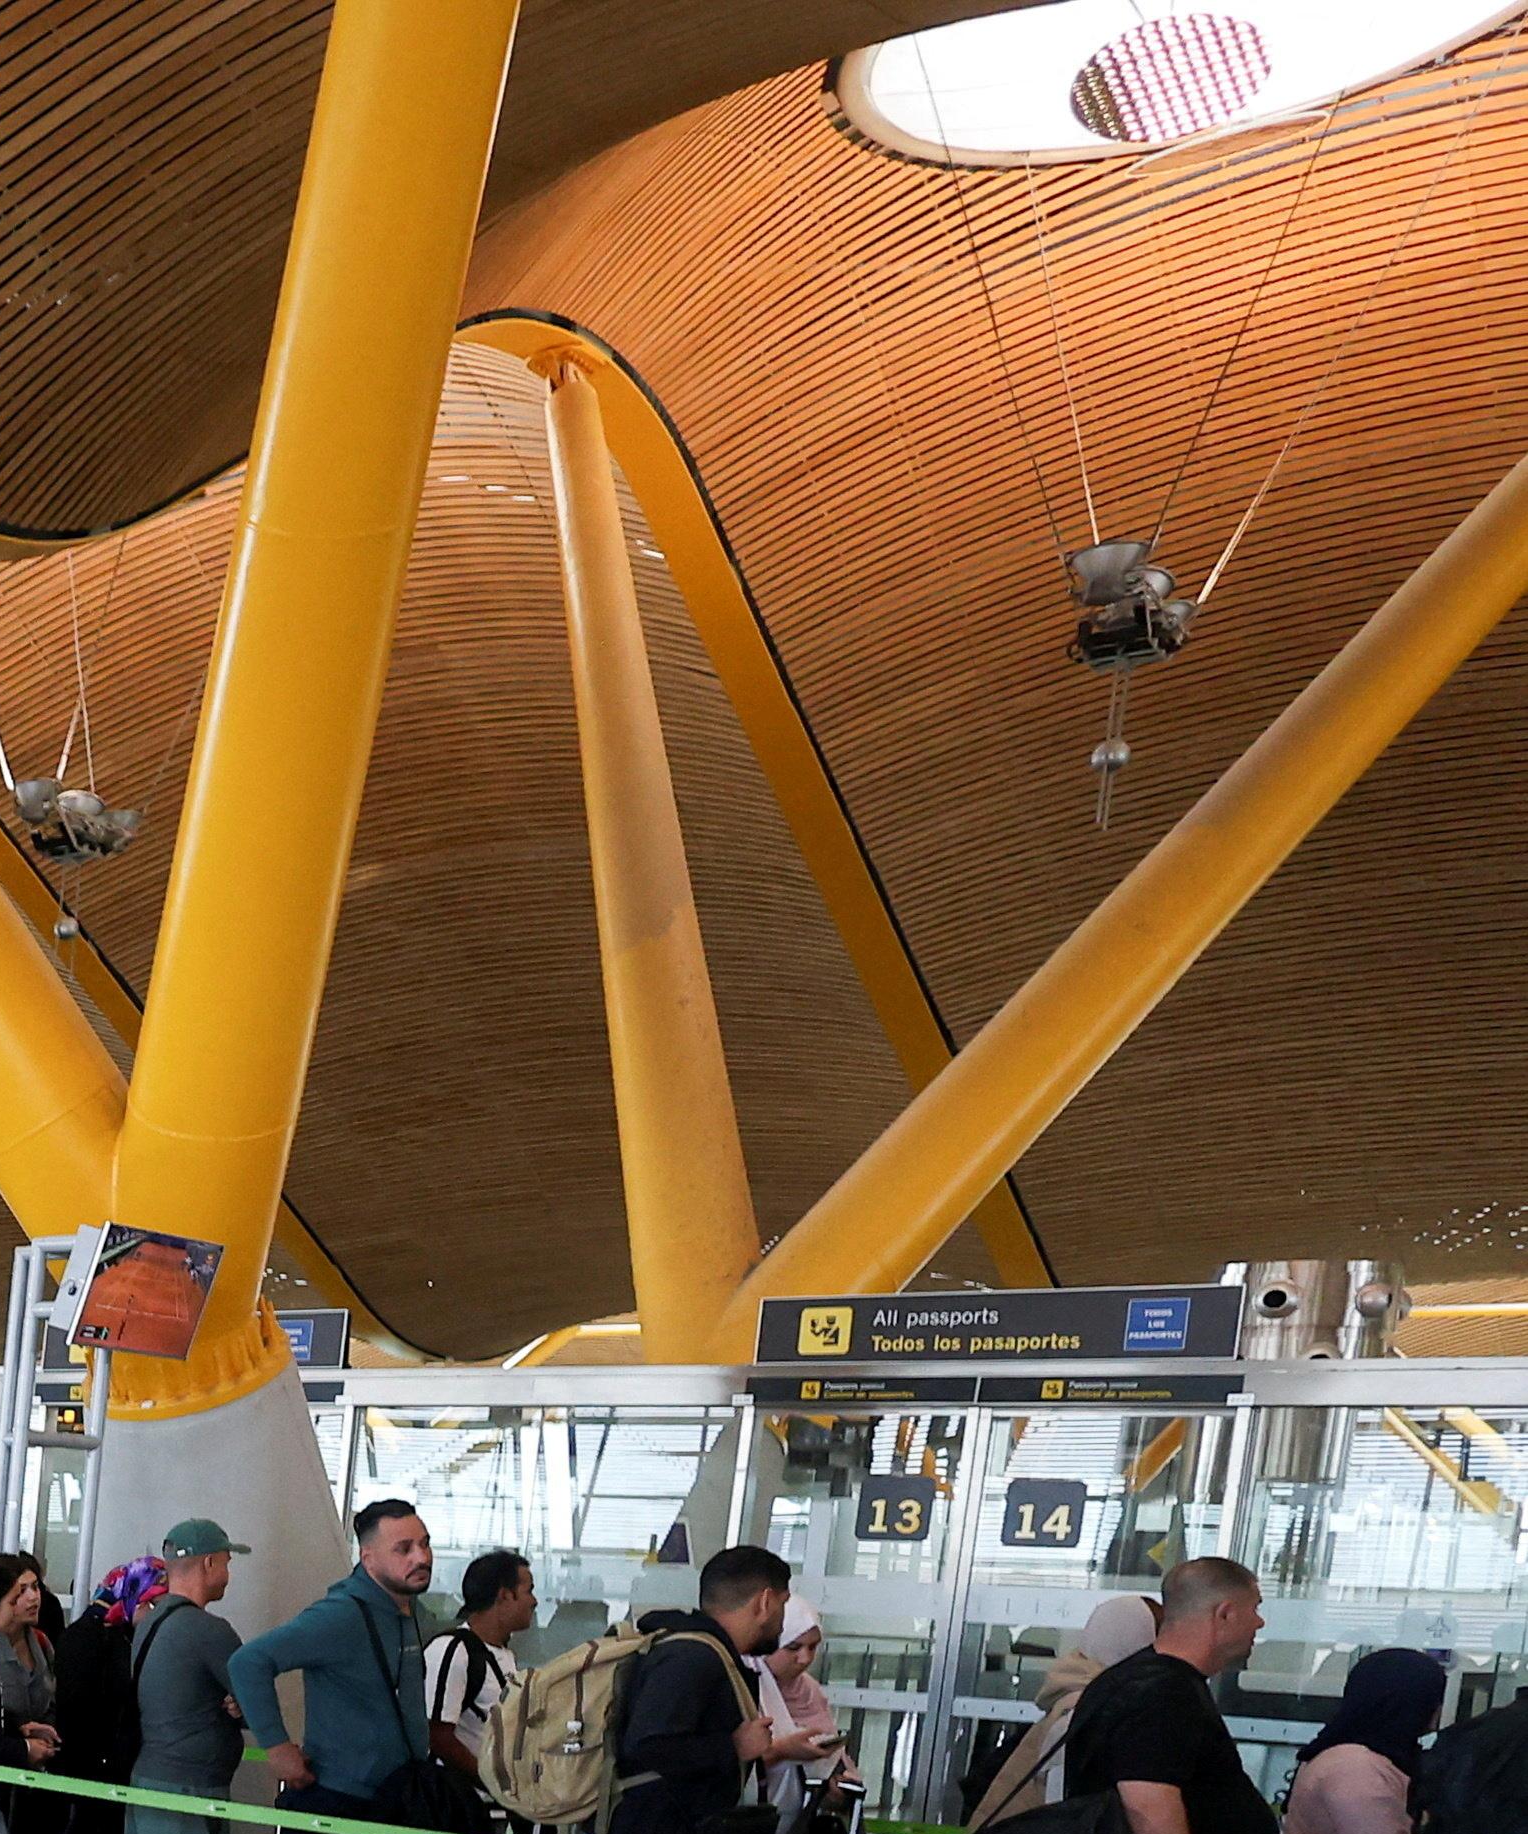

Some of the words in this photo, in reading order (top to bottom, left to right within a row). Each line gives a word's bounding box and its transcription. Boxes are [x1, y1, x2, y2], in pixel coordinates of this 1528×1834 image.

[873, 1309, 899, 1328] All
[906, 1307, 999, 1330] passports
[871, 1334, 925, 1353] Todos
[934, 1334, 961, 1352] los
[969, 1332, 1081, 1354] pasaportes
[868, 1499, 922, 1534] 13
[1014, 1503, 1072, 1541] 14
